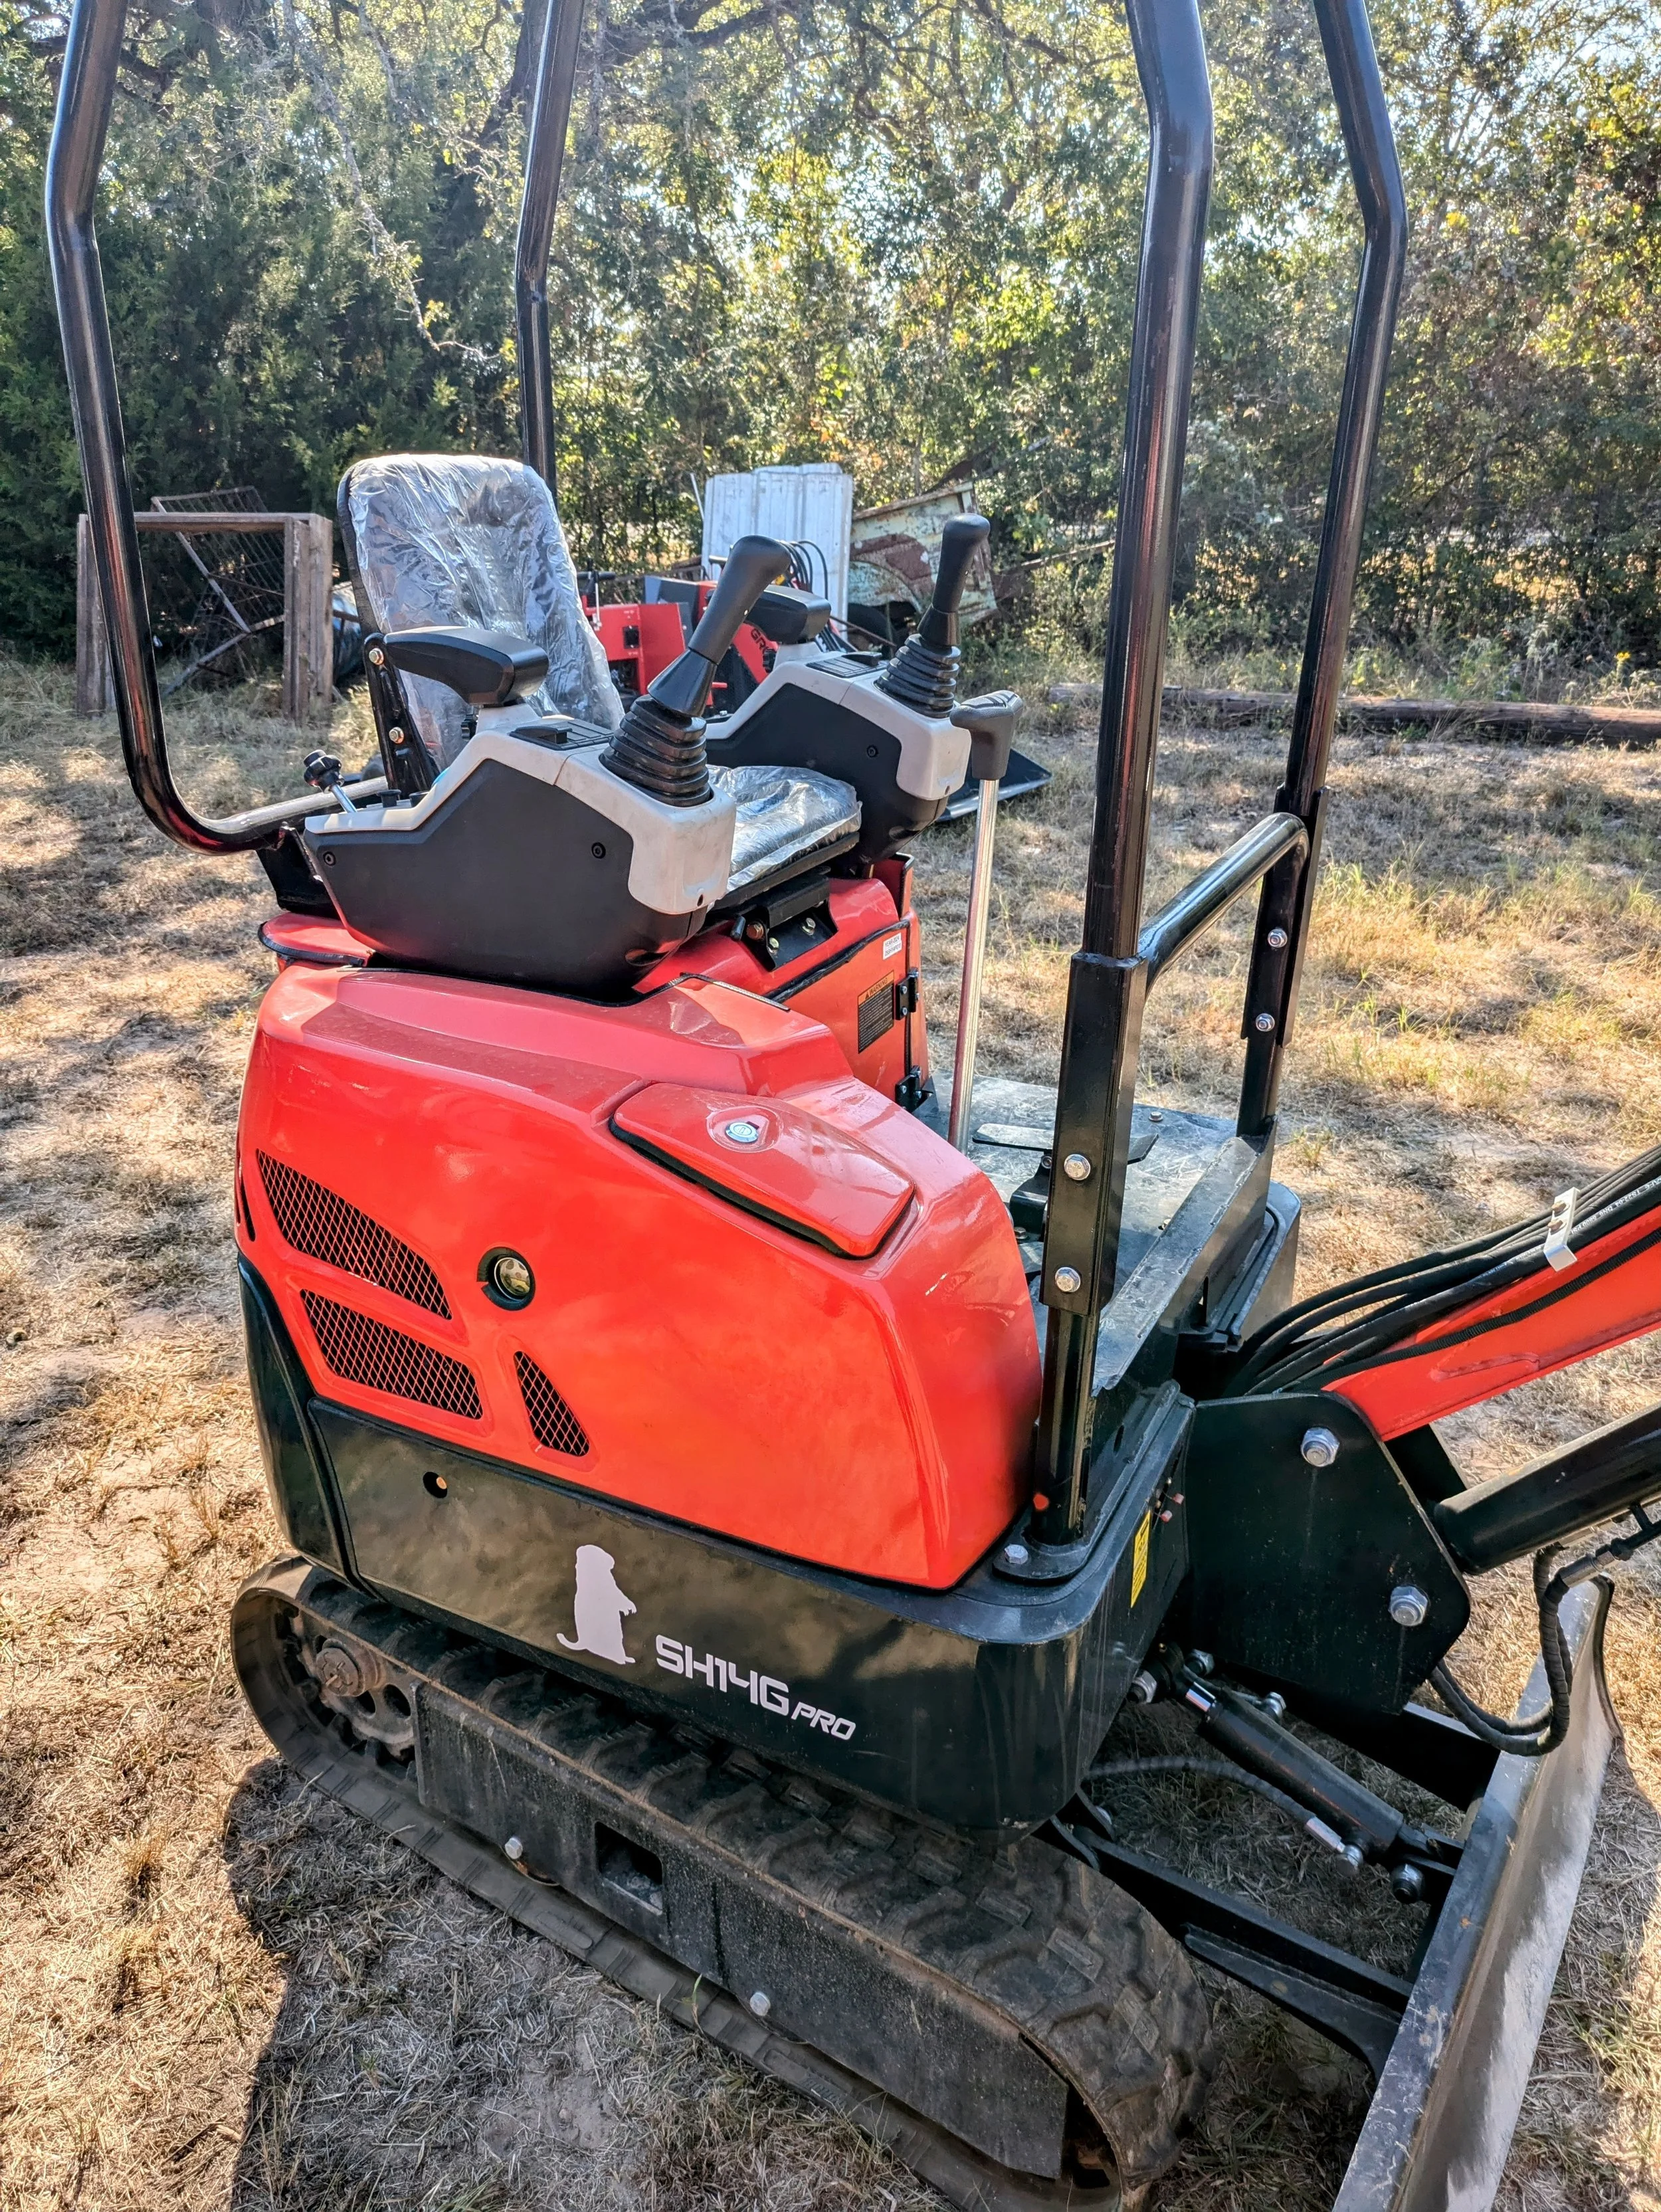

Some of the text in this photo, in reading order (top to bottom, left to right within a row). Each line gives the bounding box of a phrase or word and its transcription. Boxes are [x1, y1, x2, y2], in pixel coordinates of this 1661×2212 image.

[869, 977, 888, 996] WARNING
[1615, 1189, 1640, 1207] TS22-04
[1599, 1205, 1613, 1217] DN6
[1571, 1226, 1583, 1235] PSI
[656, 1635, 856, 1740] SH14G PRO
